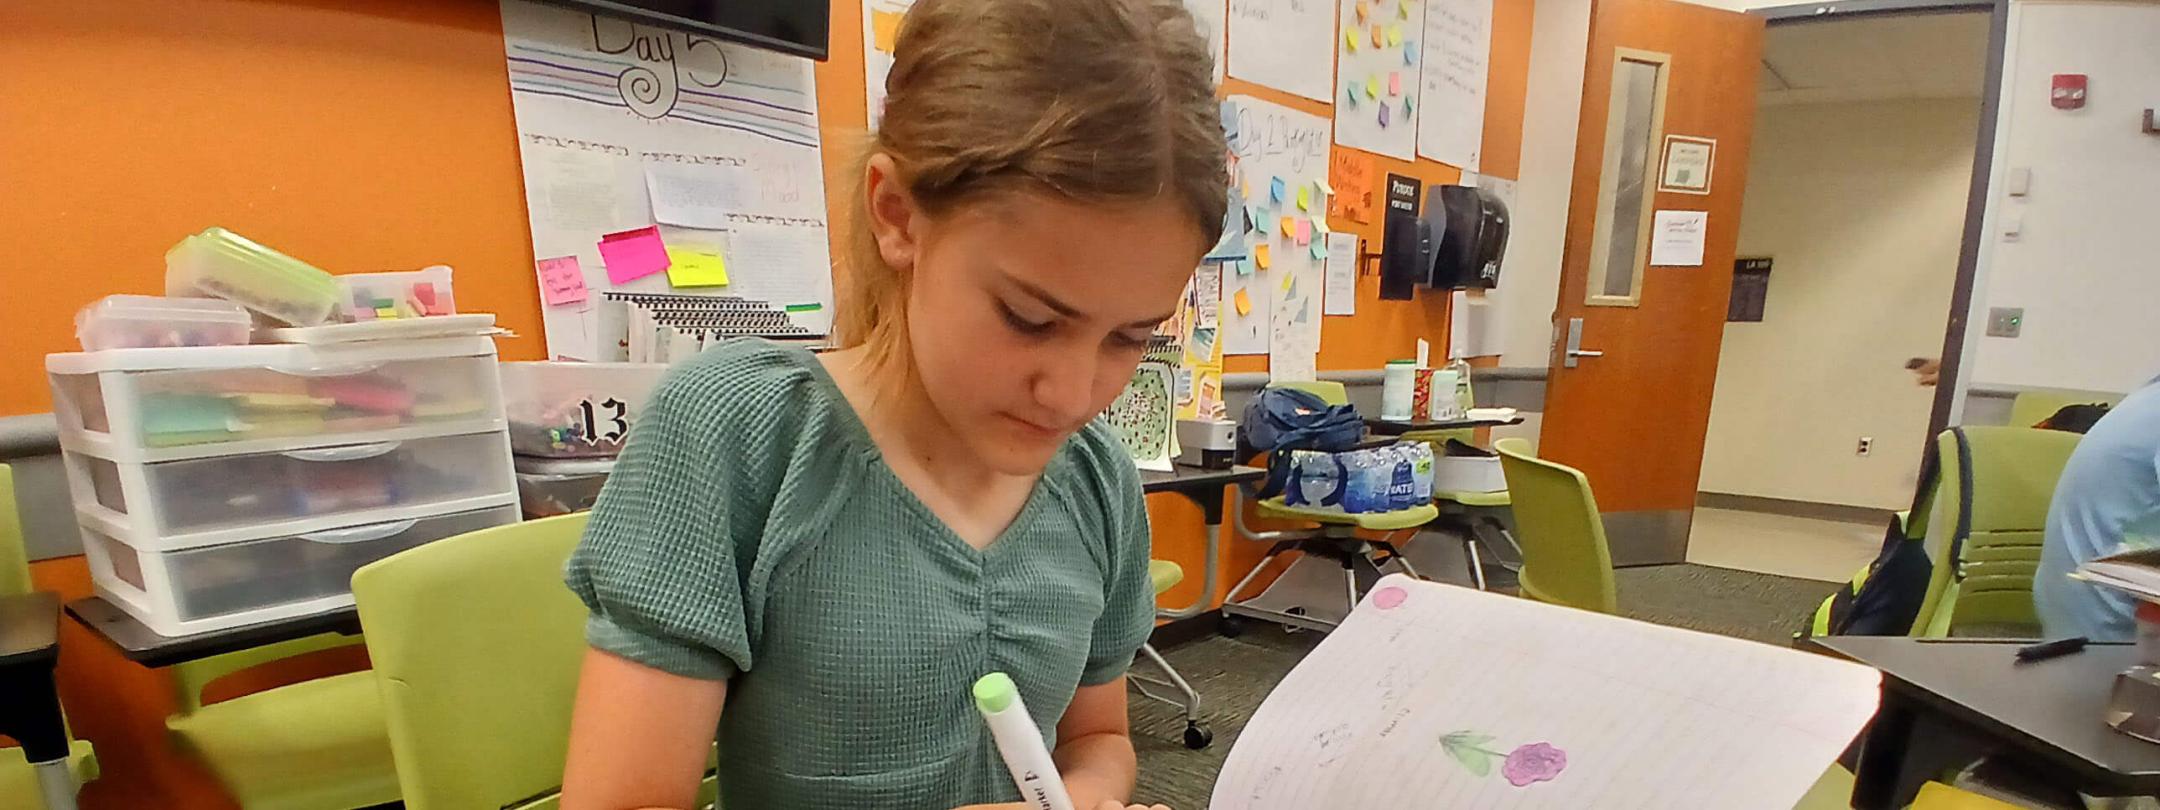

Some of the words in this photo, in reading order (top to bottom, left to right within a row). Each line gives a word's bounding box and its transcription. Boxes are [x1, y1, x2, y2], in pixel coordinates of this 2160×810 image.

[590, 13, 679, 92] Day
[686, 32, 727, 88] 5
[579, 396, 628, 442] 13
